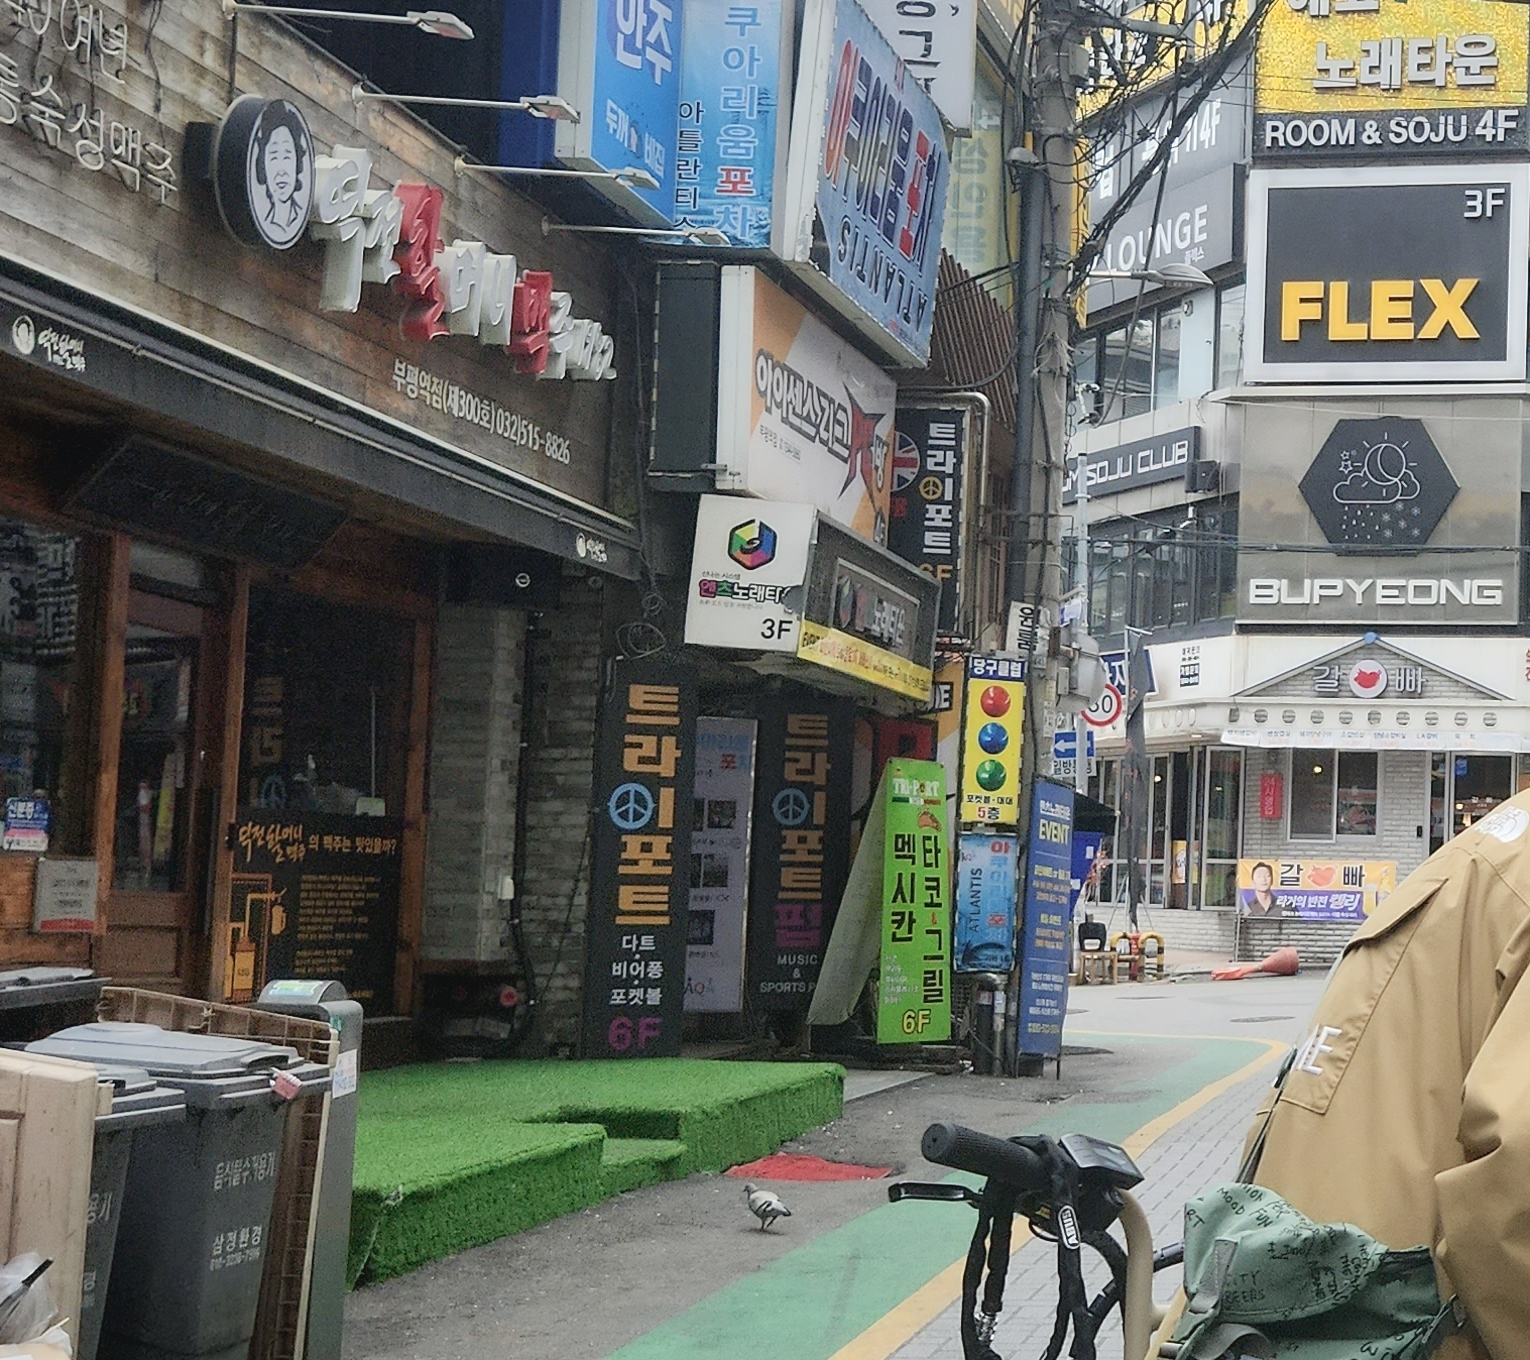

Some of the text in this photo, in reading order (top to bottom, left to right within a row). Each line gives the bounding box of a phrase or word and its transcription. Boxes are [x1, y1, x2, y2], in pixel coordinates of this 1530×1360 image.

[1312, 33, 1500, 92] 노래타운
[1265, 109, 1521, 148] ROOM & SOJU 4F
[1463, 186, 1507, 220] 3F
[1106, 202, 1210, 277] LOUNGE
[835, 218, 929, 334] ATLANTIS
[1279, 276, 1482, 342] FLEX
[1087, 439, 1190, 482] SOJU CLUB
[1248, 578, 1503, 606] BUPYEONG
[760, 618, 795, 640] 3F
[1312, 666, 1428, 695] 갈 빠
[606, 683, 682, 927] 트라이포트
[1038, 821, 1071, 846] EVENT
[890, 832, 918, 944] 멕시칸
[1279, 863, 1366, 888] 갈 빠
[968, 866, 984, 934] ATLANTIS
[621, 935, 657, 952] 다트
[612, 961, 664, 980] 비어퐁
[777, 954, 818, 966] MUSIC
[609, 987, 663, 1006] 포켓볼
[760, 981, 807, 994] SPORTS
[608, 1016, 663, 1051] 6F
[902, 1008, 932, 1035] 6F
